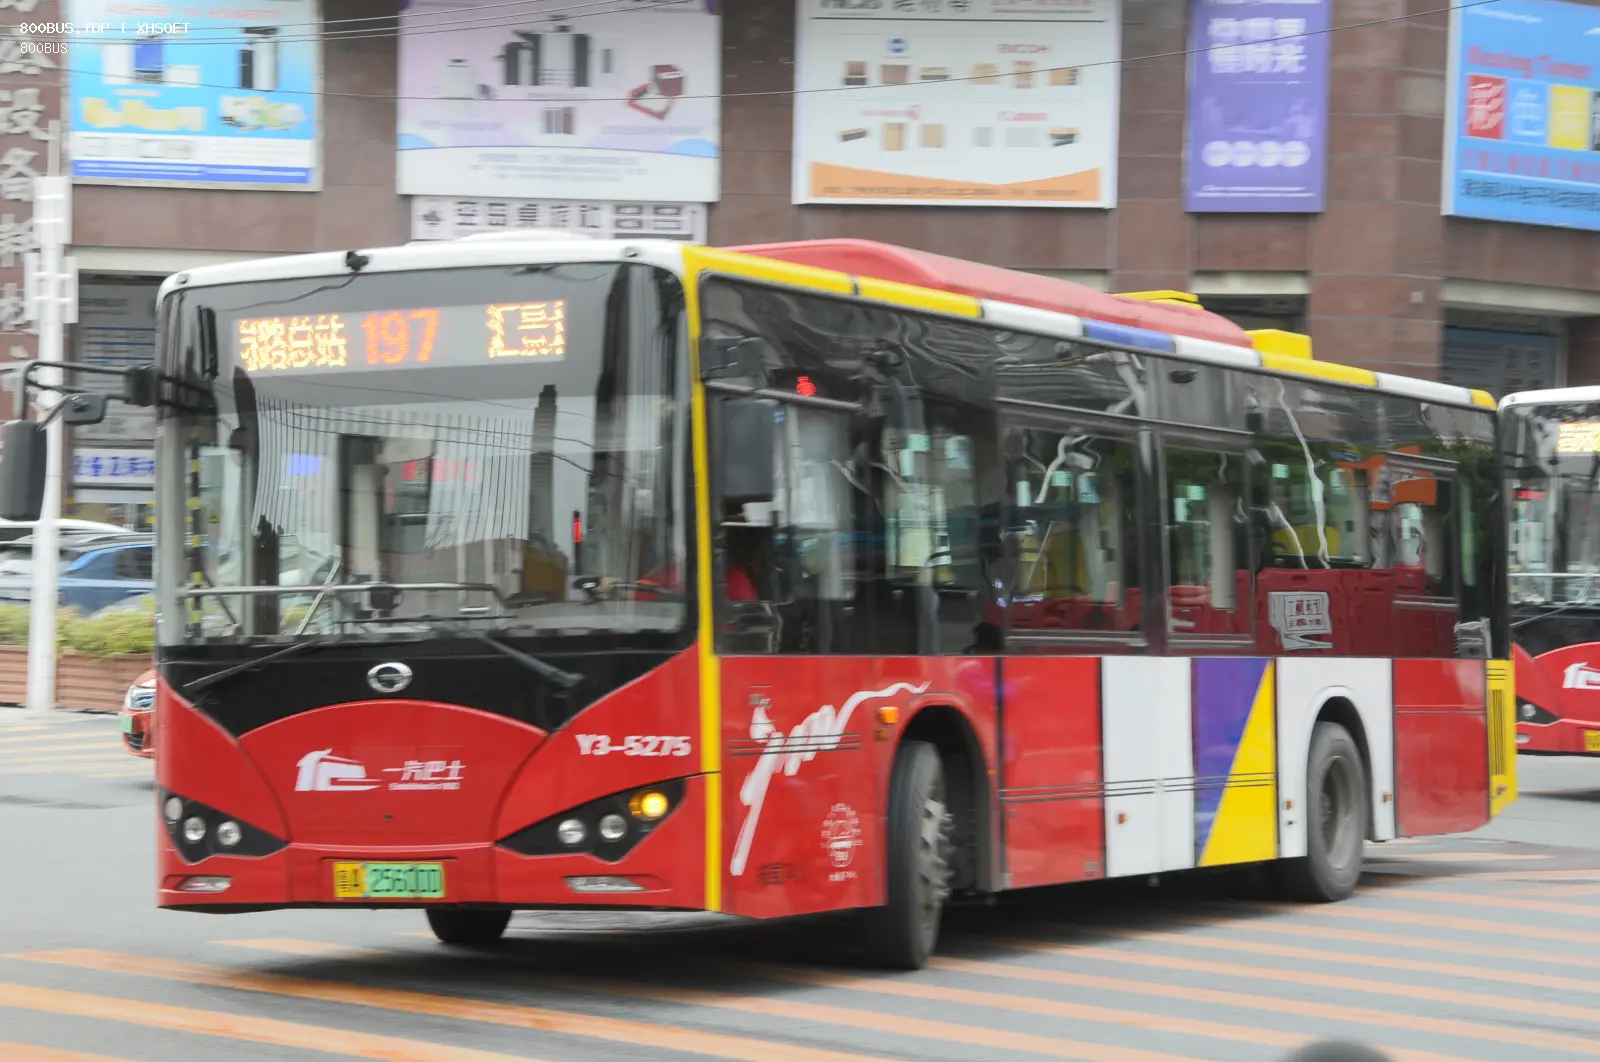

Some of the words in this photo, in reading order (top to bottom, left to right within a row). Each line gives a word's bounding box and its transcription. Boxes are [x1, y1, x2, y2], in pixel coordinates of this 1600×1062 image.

[361, 309, 440, 365] 197
[575, 734, 692, 756] Y3-5275
[382, 760, 467, 780] 一汽巴士
